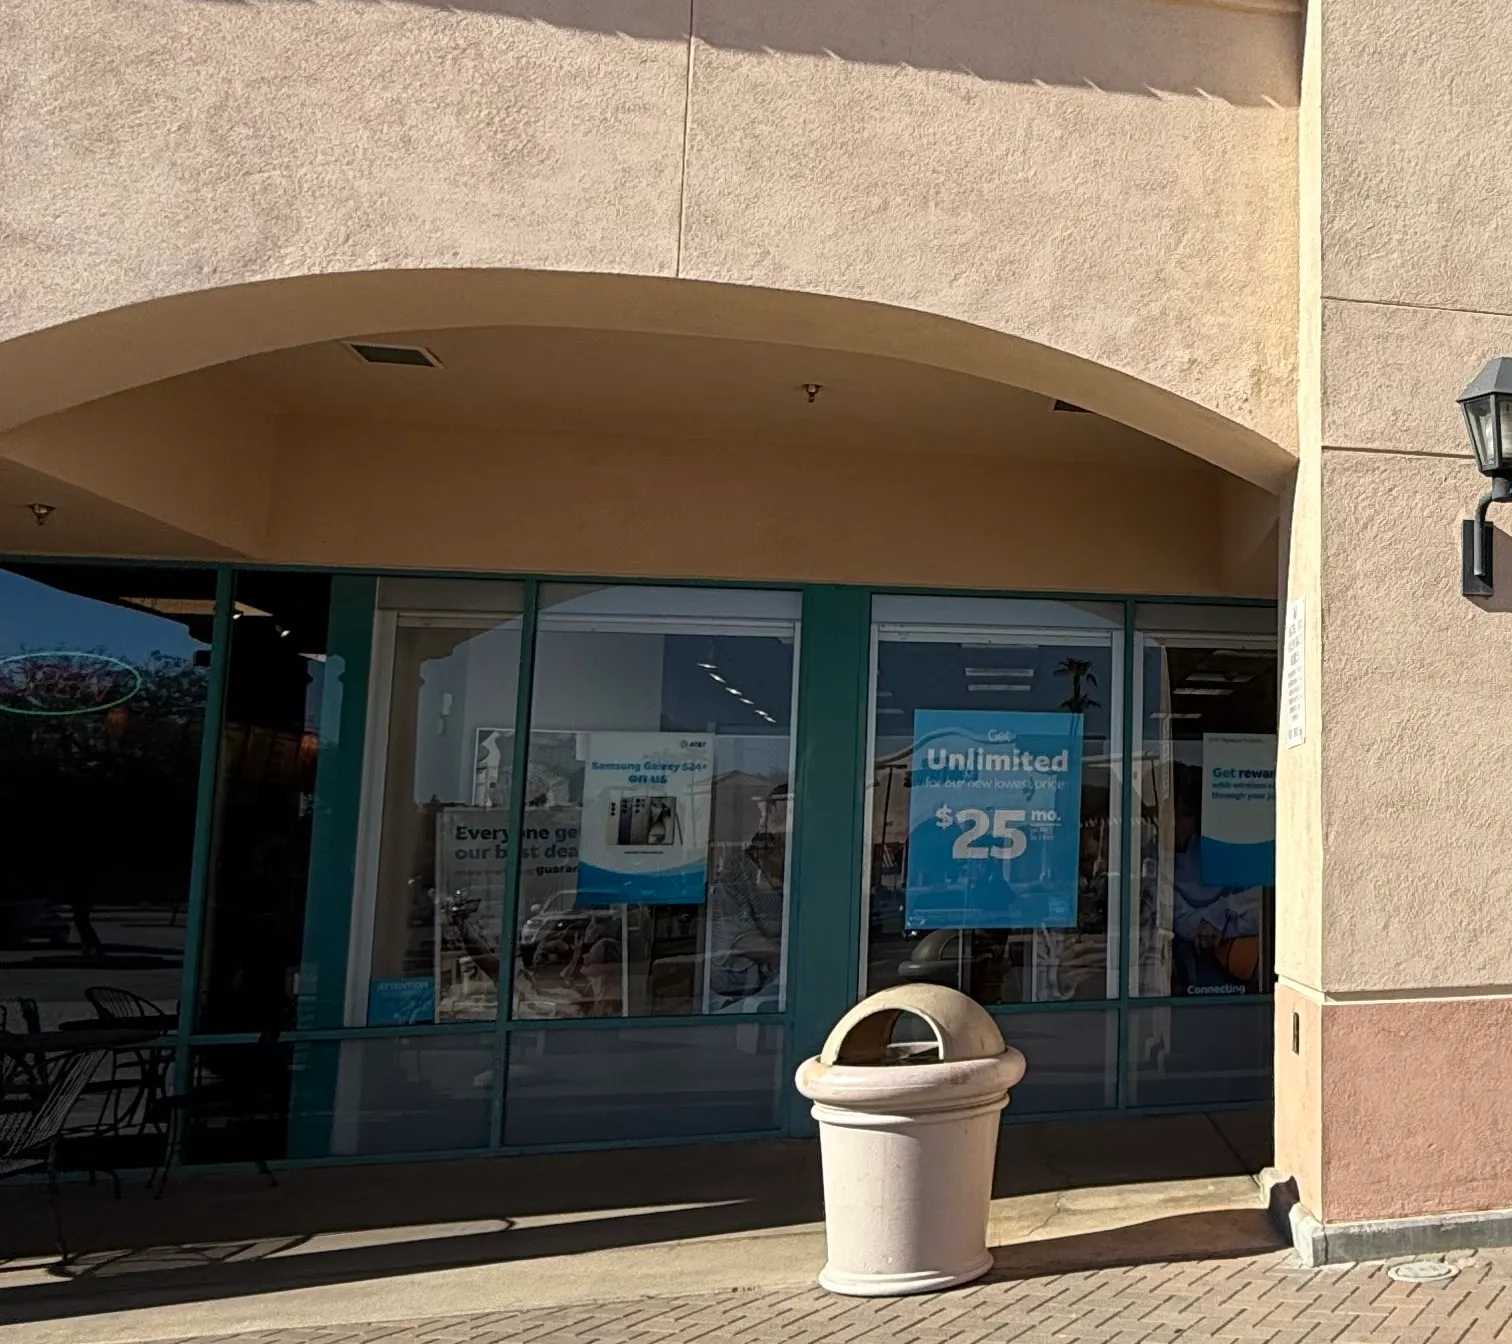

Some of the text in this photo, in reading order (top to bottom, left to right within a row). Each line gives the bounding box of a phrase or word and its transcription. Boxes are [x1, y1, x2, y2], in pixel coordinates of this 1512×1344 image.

[591, 761, 641, 772] Samsung
[643, 761, 680, 773] Galaxy
[927, 748, 1069, 773] Unlimited
[628, 774, 668, 784] on us
[1212, 767, 1237, 779] Get
[1034, 778, 1065, 792] price
[1030, 808, 1062, 822] mo.
[455, 826, 550, 843] Everyne
[454, 847, 490, 860] our
[495, 844, 540, 859] bst
[1186, 984, 1246, 994] Connecting
